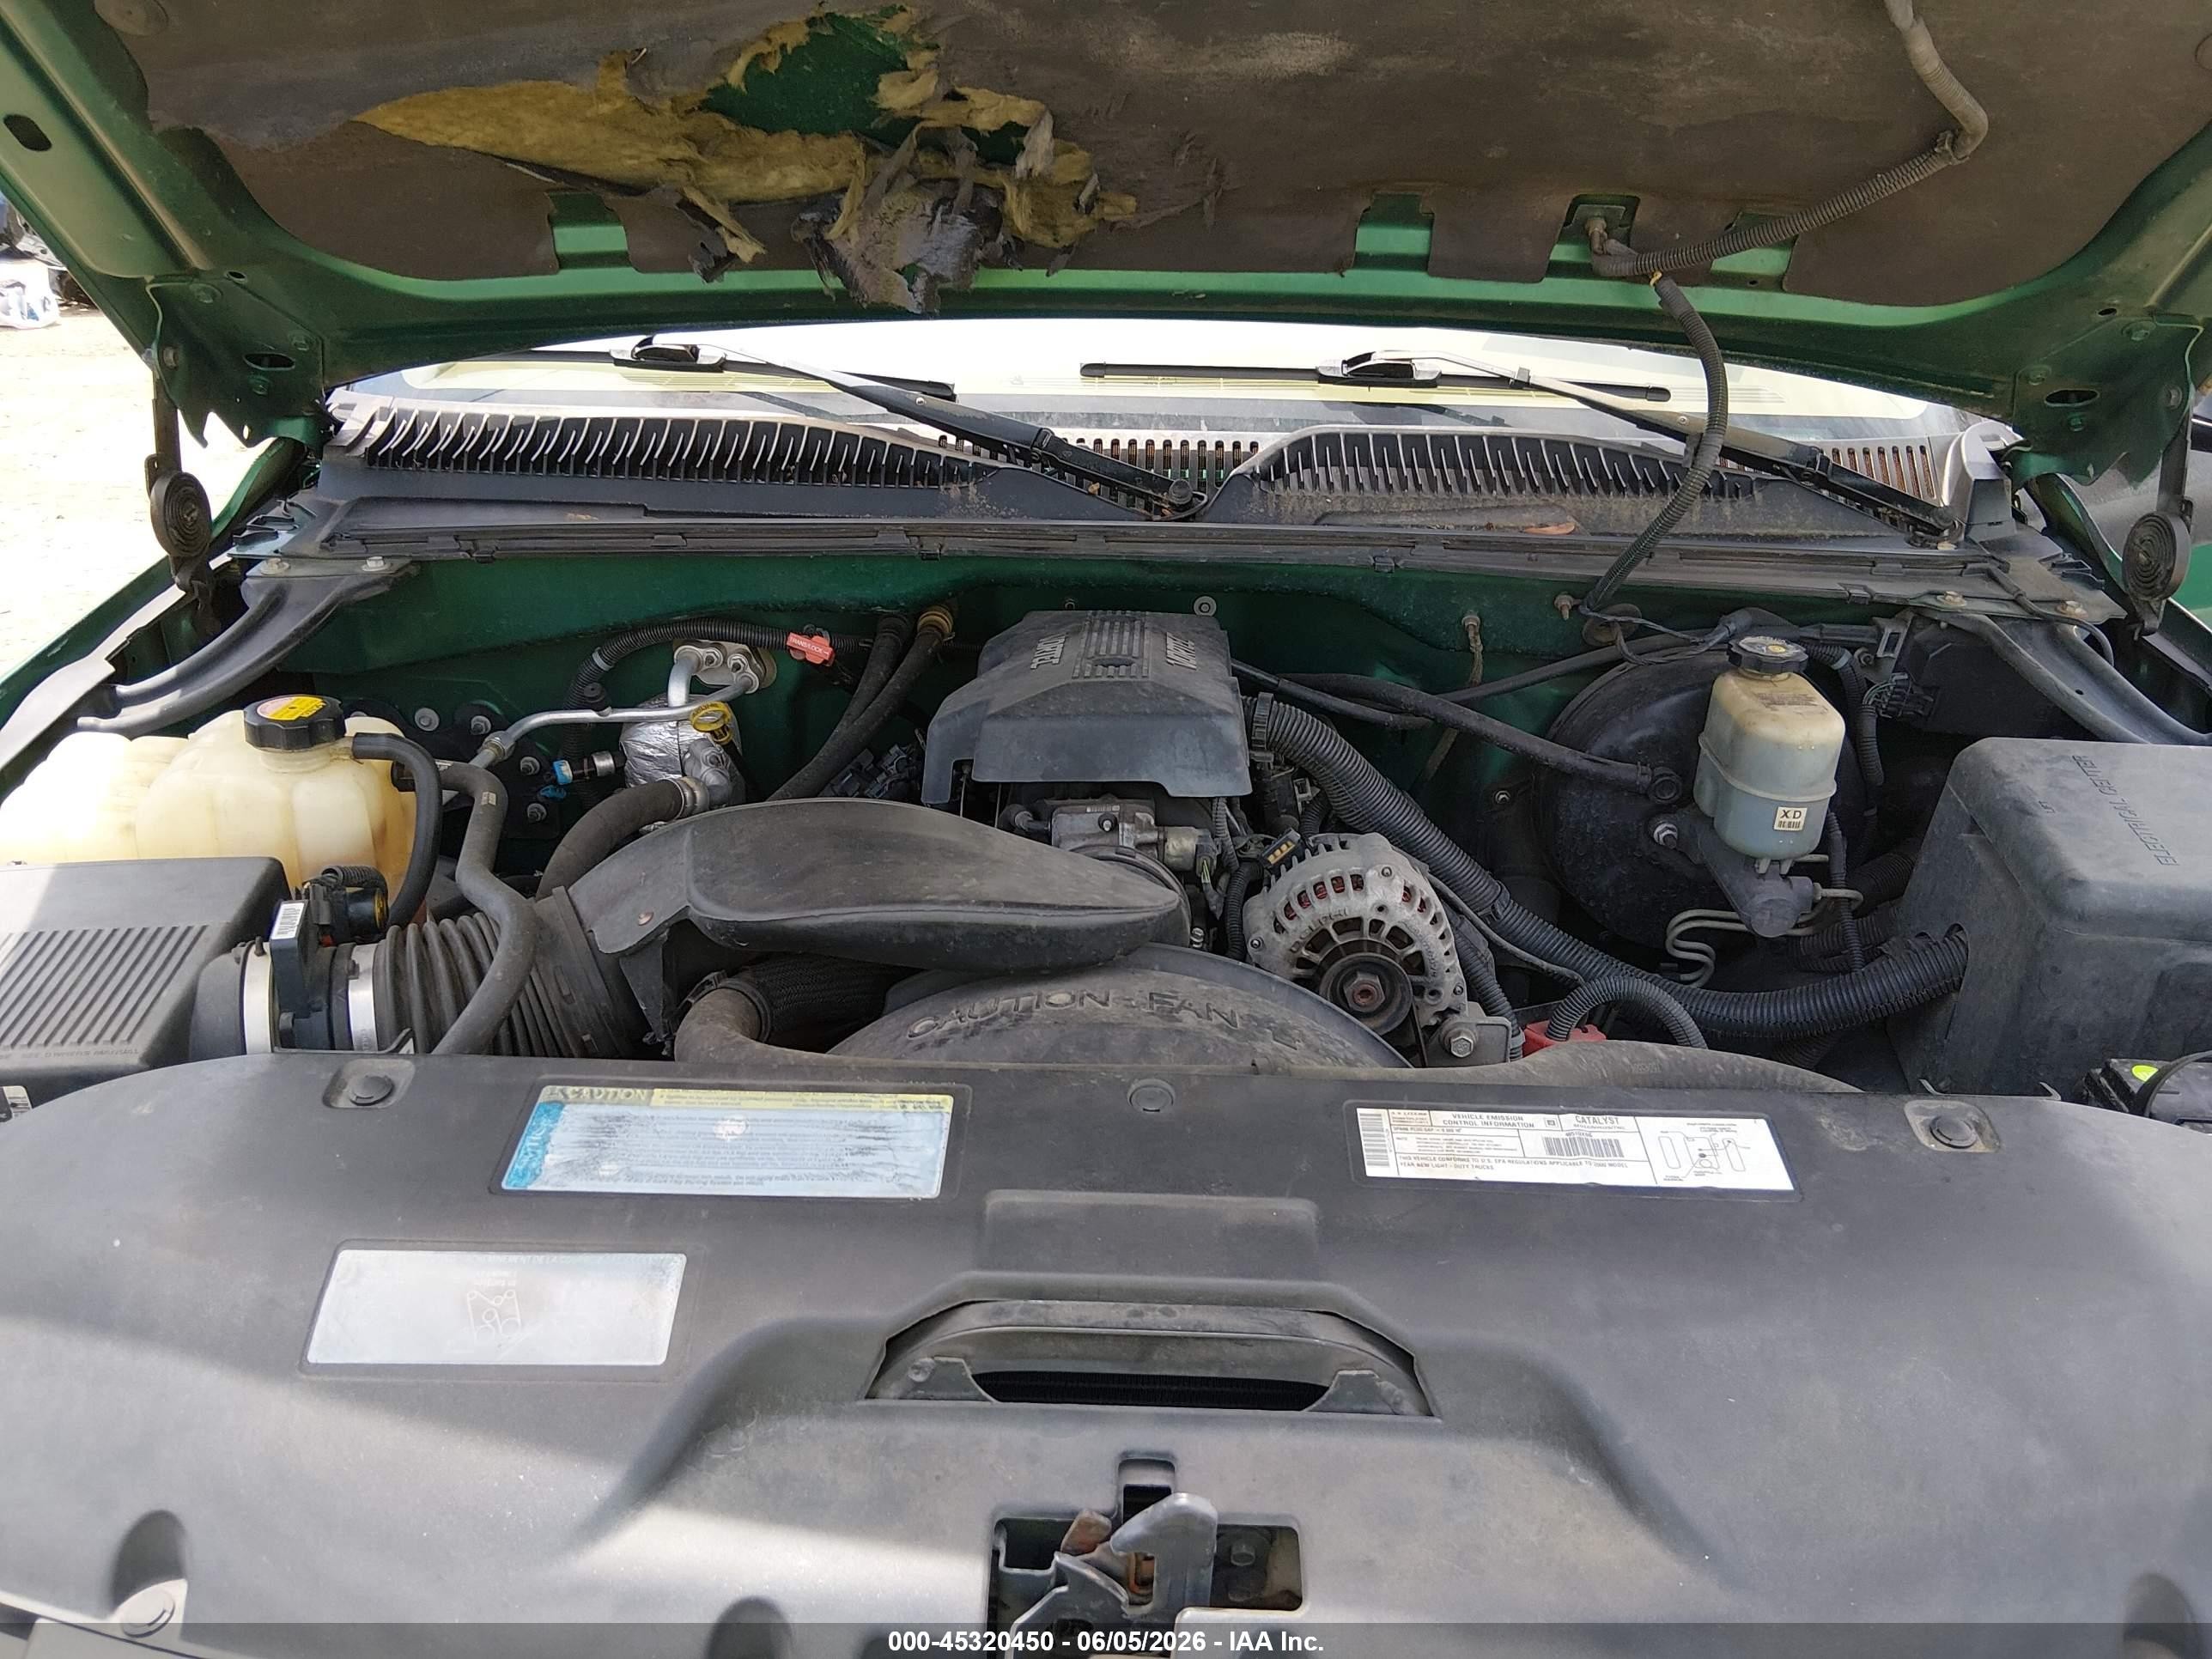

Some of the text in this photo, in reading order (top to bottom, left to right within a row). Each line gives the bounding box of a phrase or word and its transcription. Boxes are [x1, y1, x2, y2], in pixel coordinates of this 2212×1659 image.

[1030, 633, 1066, 670] VORTEC
[1166, 631, 1197, 670] VORTEC
[2071, 755, 2180, 866] ELECTRICAL CENTER
[907, 988, 1111, 1039] CAUTION
[1146, 990, 1240, 1030] FAN
[567, 1085, 646, 1099] CAUTION
[1575, 1115, 1620, 1125] CATALYST
